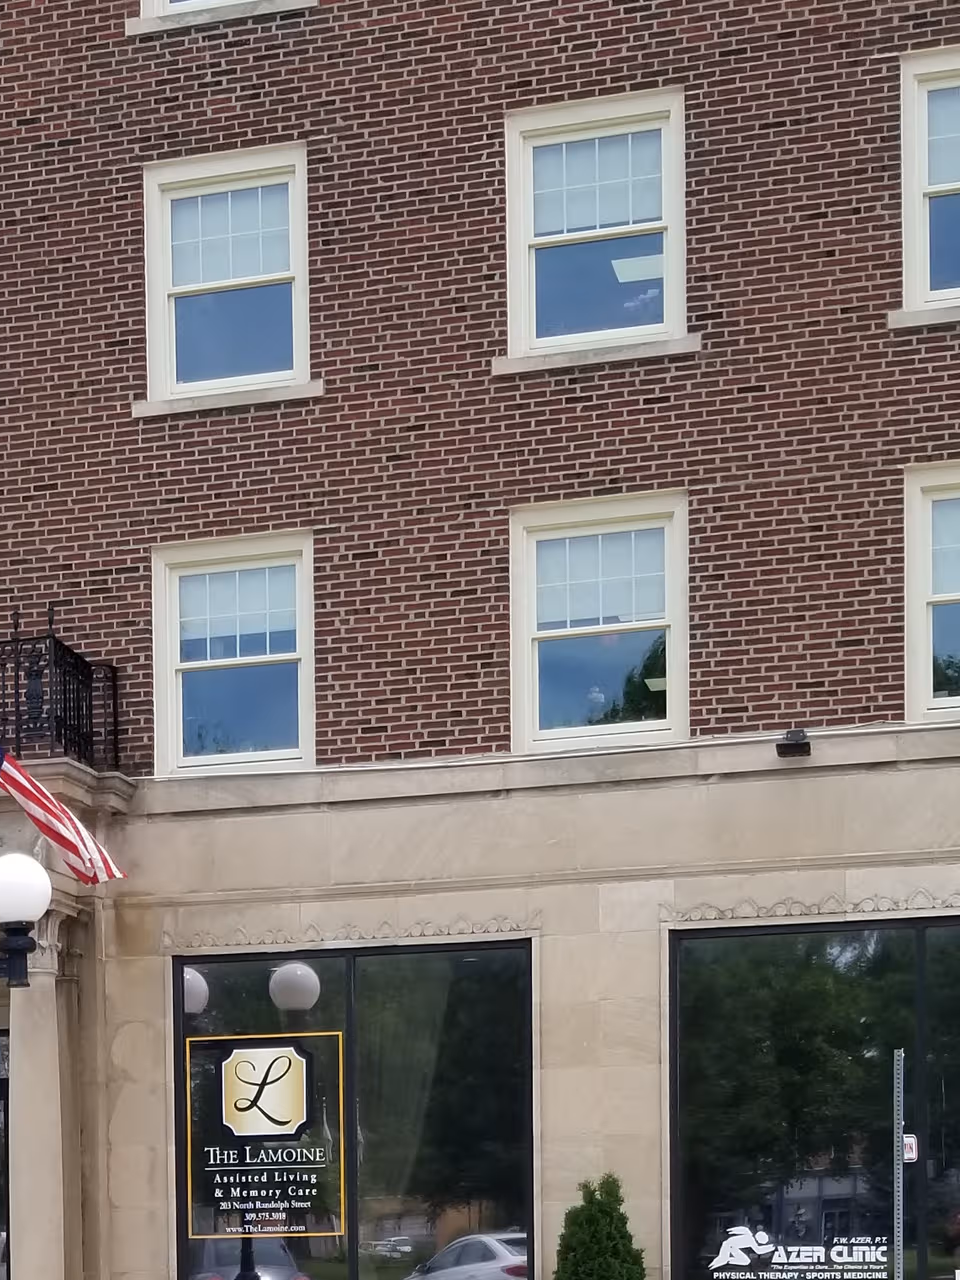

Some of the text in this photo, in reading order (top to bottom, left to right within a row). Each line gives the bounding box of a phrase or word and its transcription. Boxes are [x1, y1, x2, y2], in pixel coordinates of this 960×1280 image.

[204, 1145, 326, 1165] THE LAMOINE
[213, 1171, 318, 1184] Assisted Living
[214, 1186, 318, 1199] & Memory Care
[219, 1200, 311, 1211] 203 North Randolph Street
[225, 1224, 306, 1233] www.TheLamoine.com
[832, 1236, 849, 1244] F.W.
[849, 1236, 873, 1245] AZER,
[771, 1245, 888, 1263] AZER CLINIC
[713, 1271, 888, 1280] PHYSICAL THERAPY SPORTS MEDICINE
